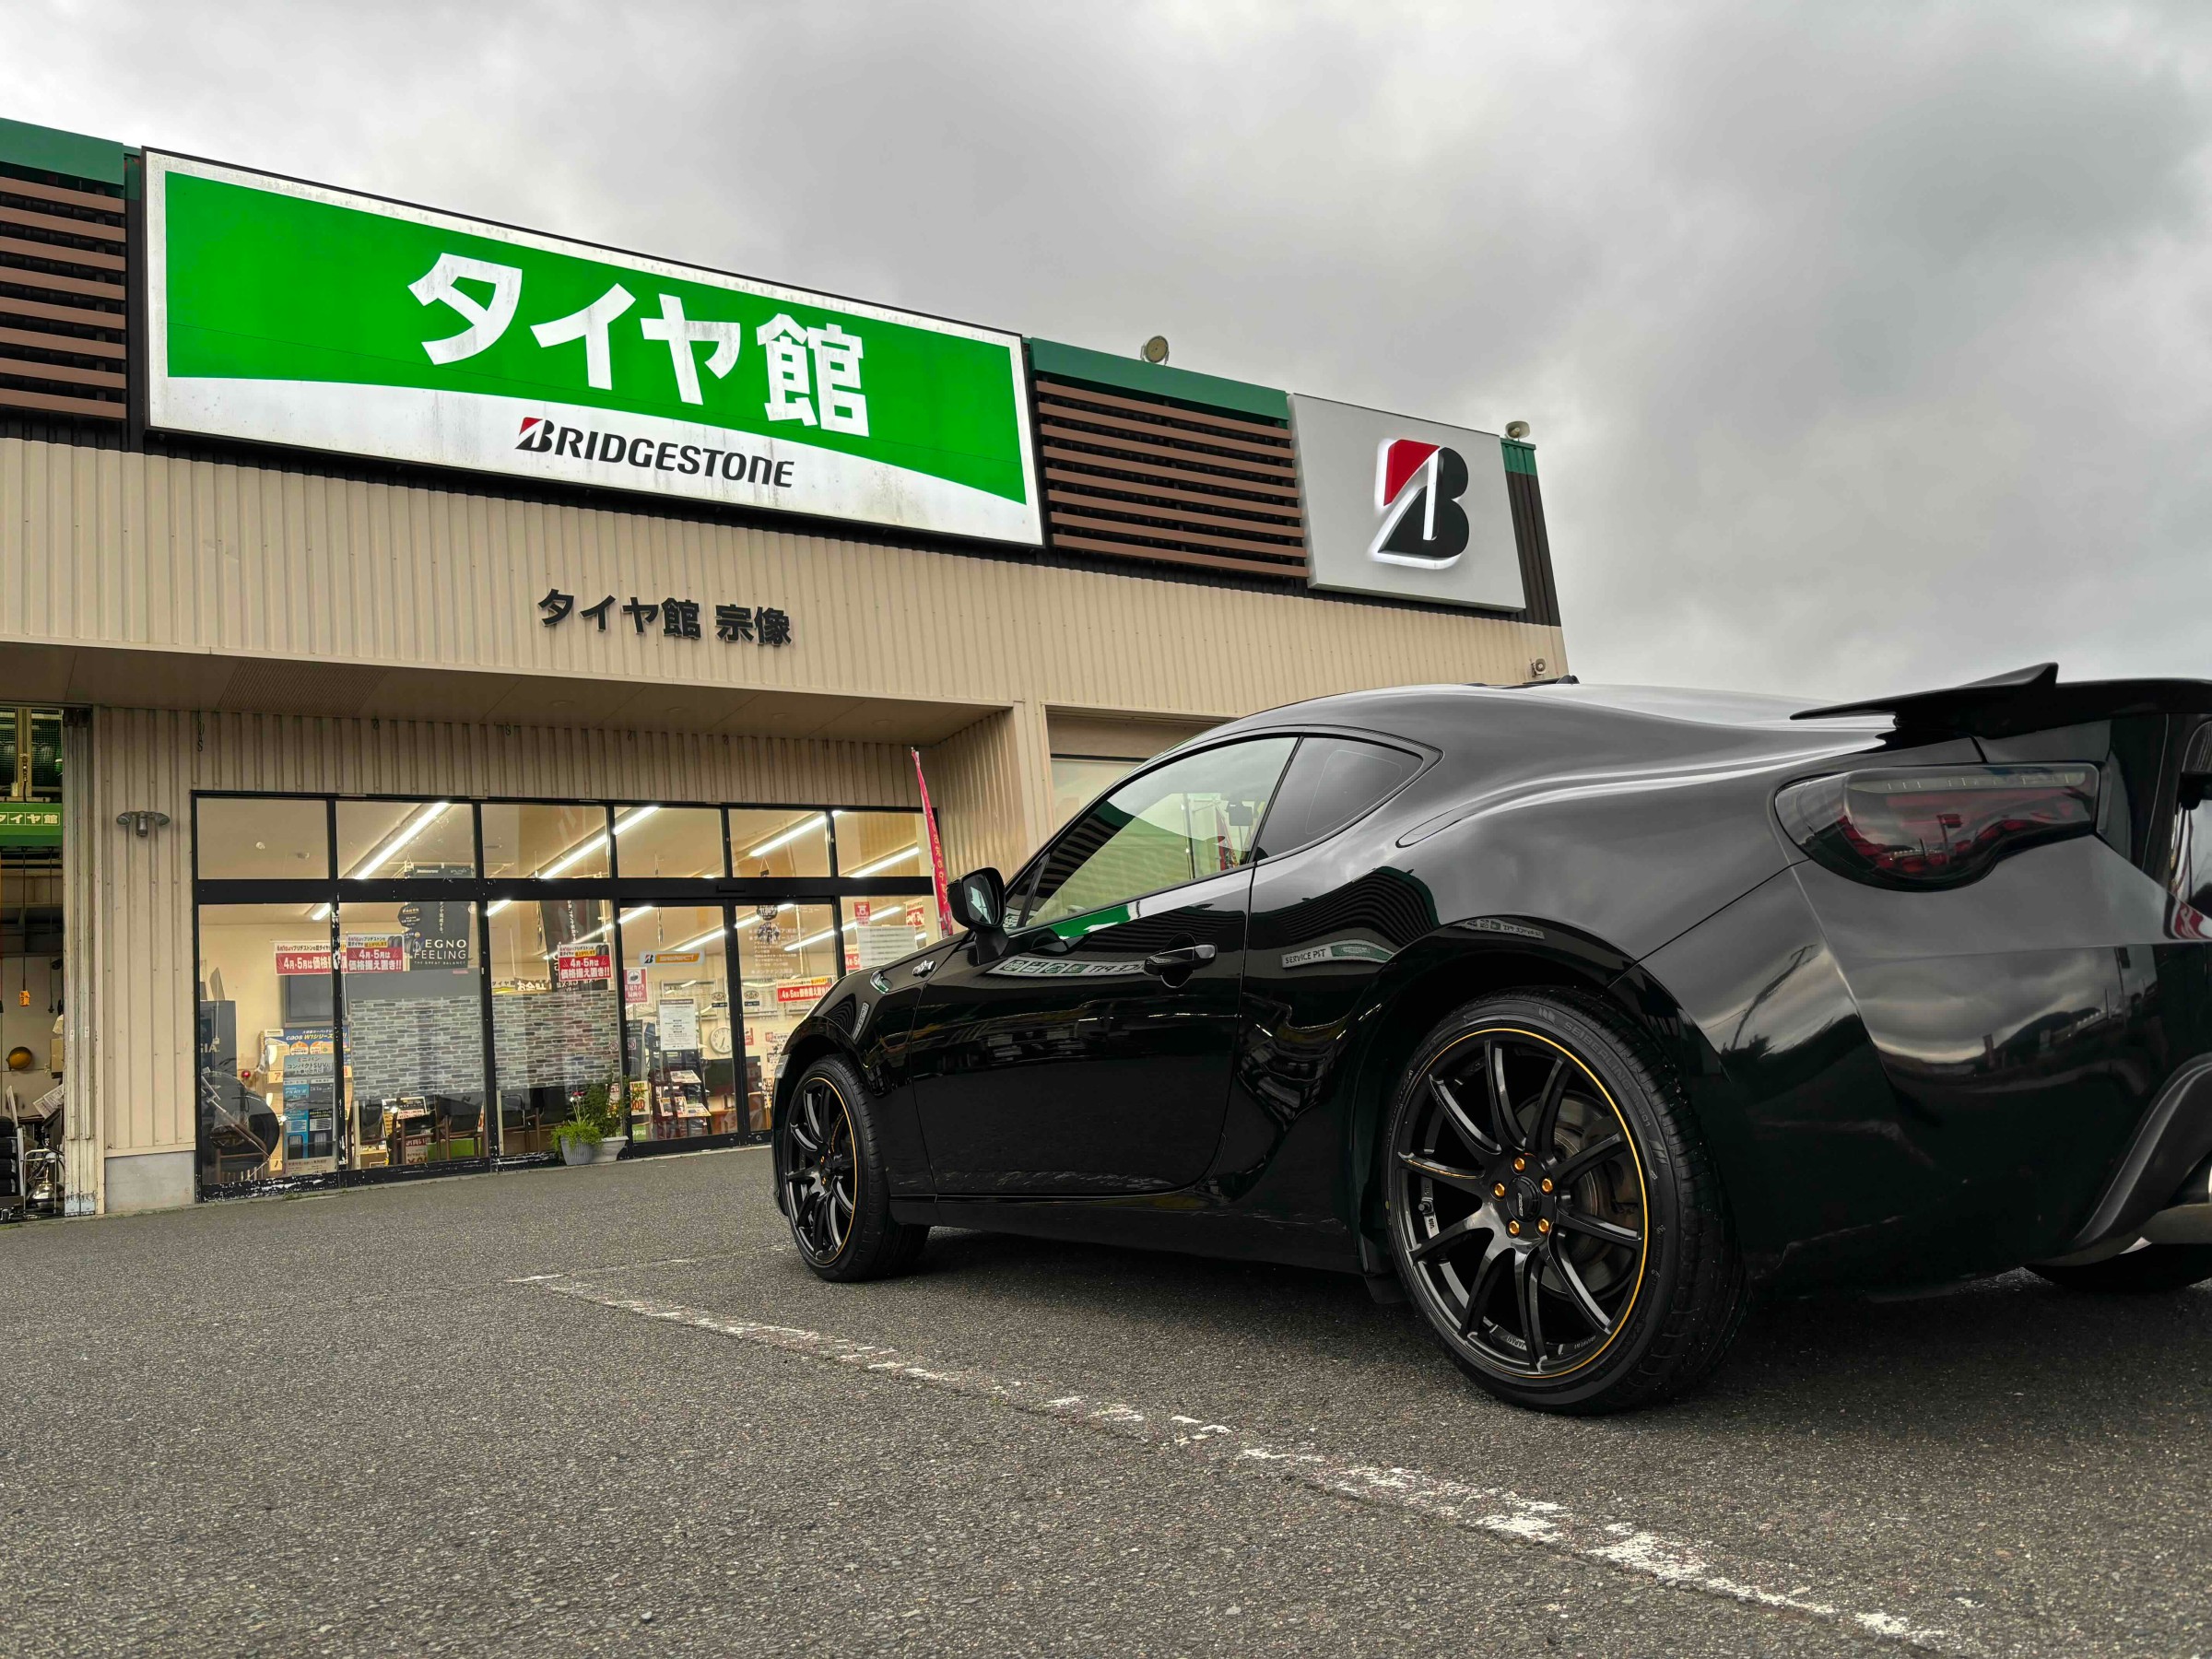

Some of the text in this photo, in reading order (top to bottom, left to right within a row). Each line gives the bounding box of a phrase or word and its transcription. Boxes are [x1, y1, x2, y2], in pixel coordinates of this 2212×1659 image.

[406, 252, 870, 438] タイヤ館
[514, 417, 794, 488] BRIDGESTONE
[537, 588, 792, 646] タイヤ館 宗像
[414, 950, 466, 959] FEELING
[1285, 948, 1326, 964] SERVICE PIT
[1563, 1021, 1632, 1090] SEIBERLING
